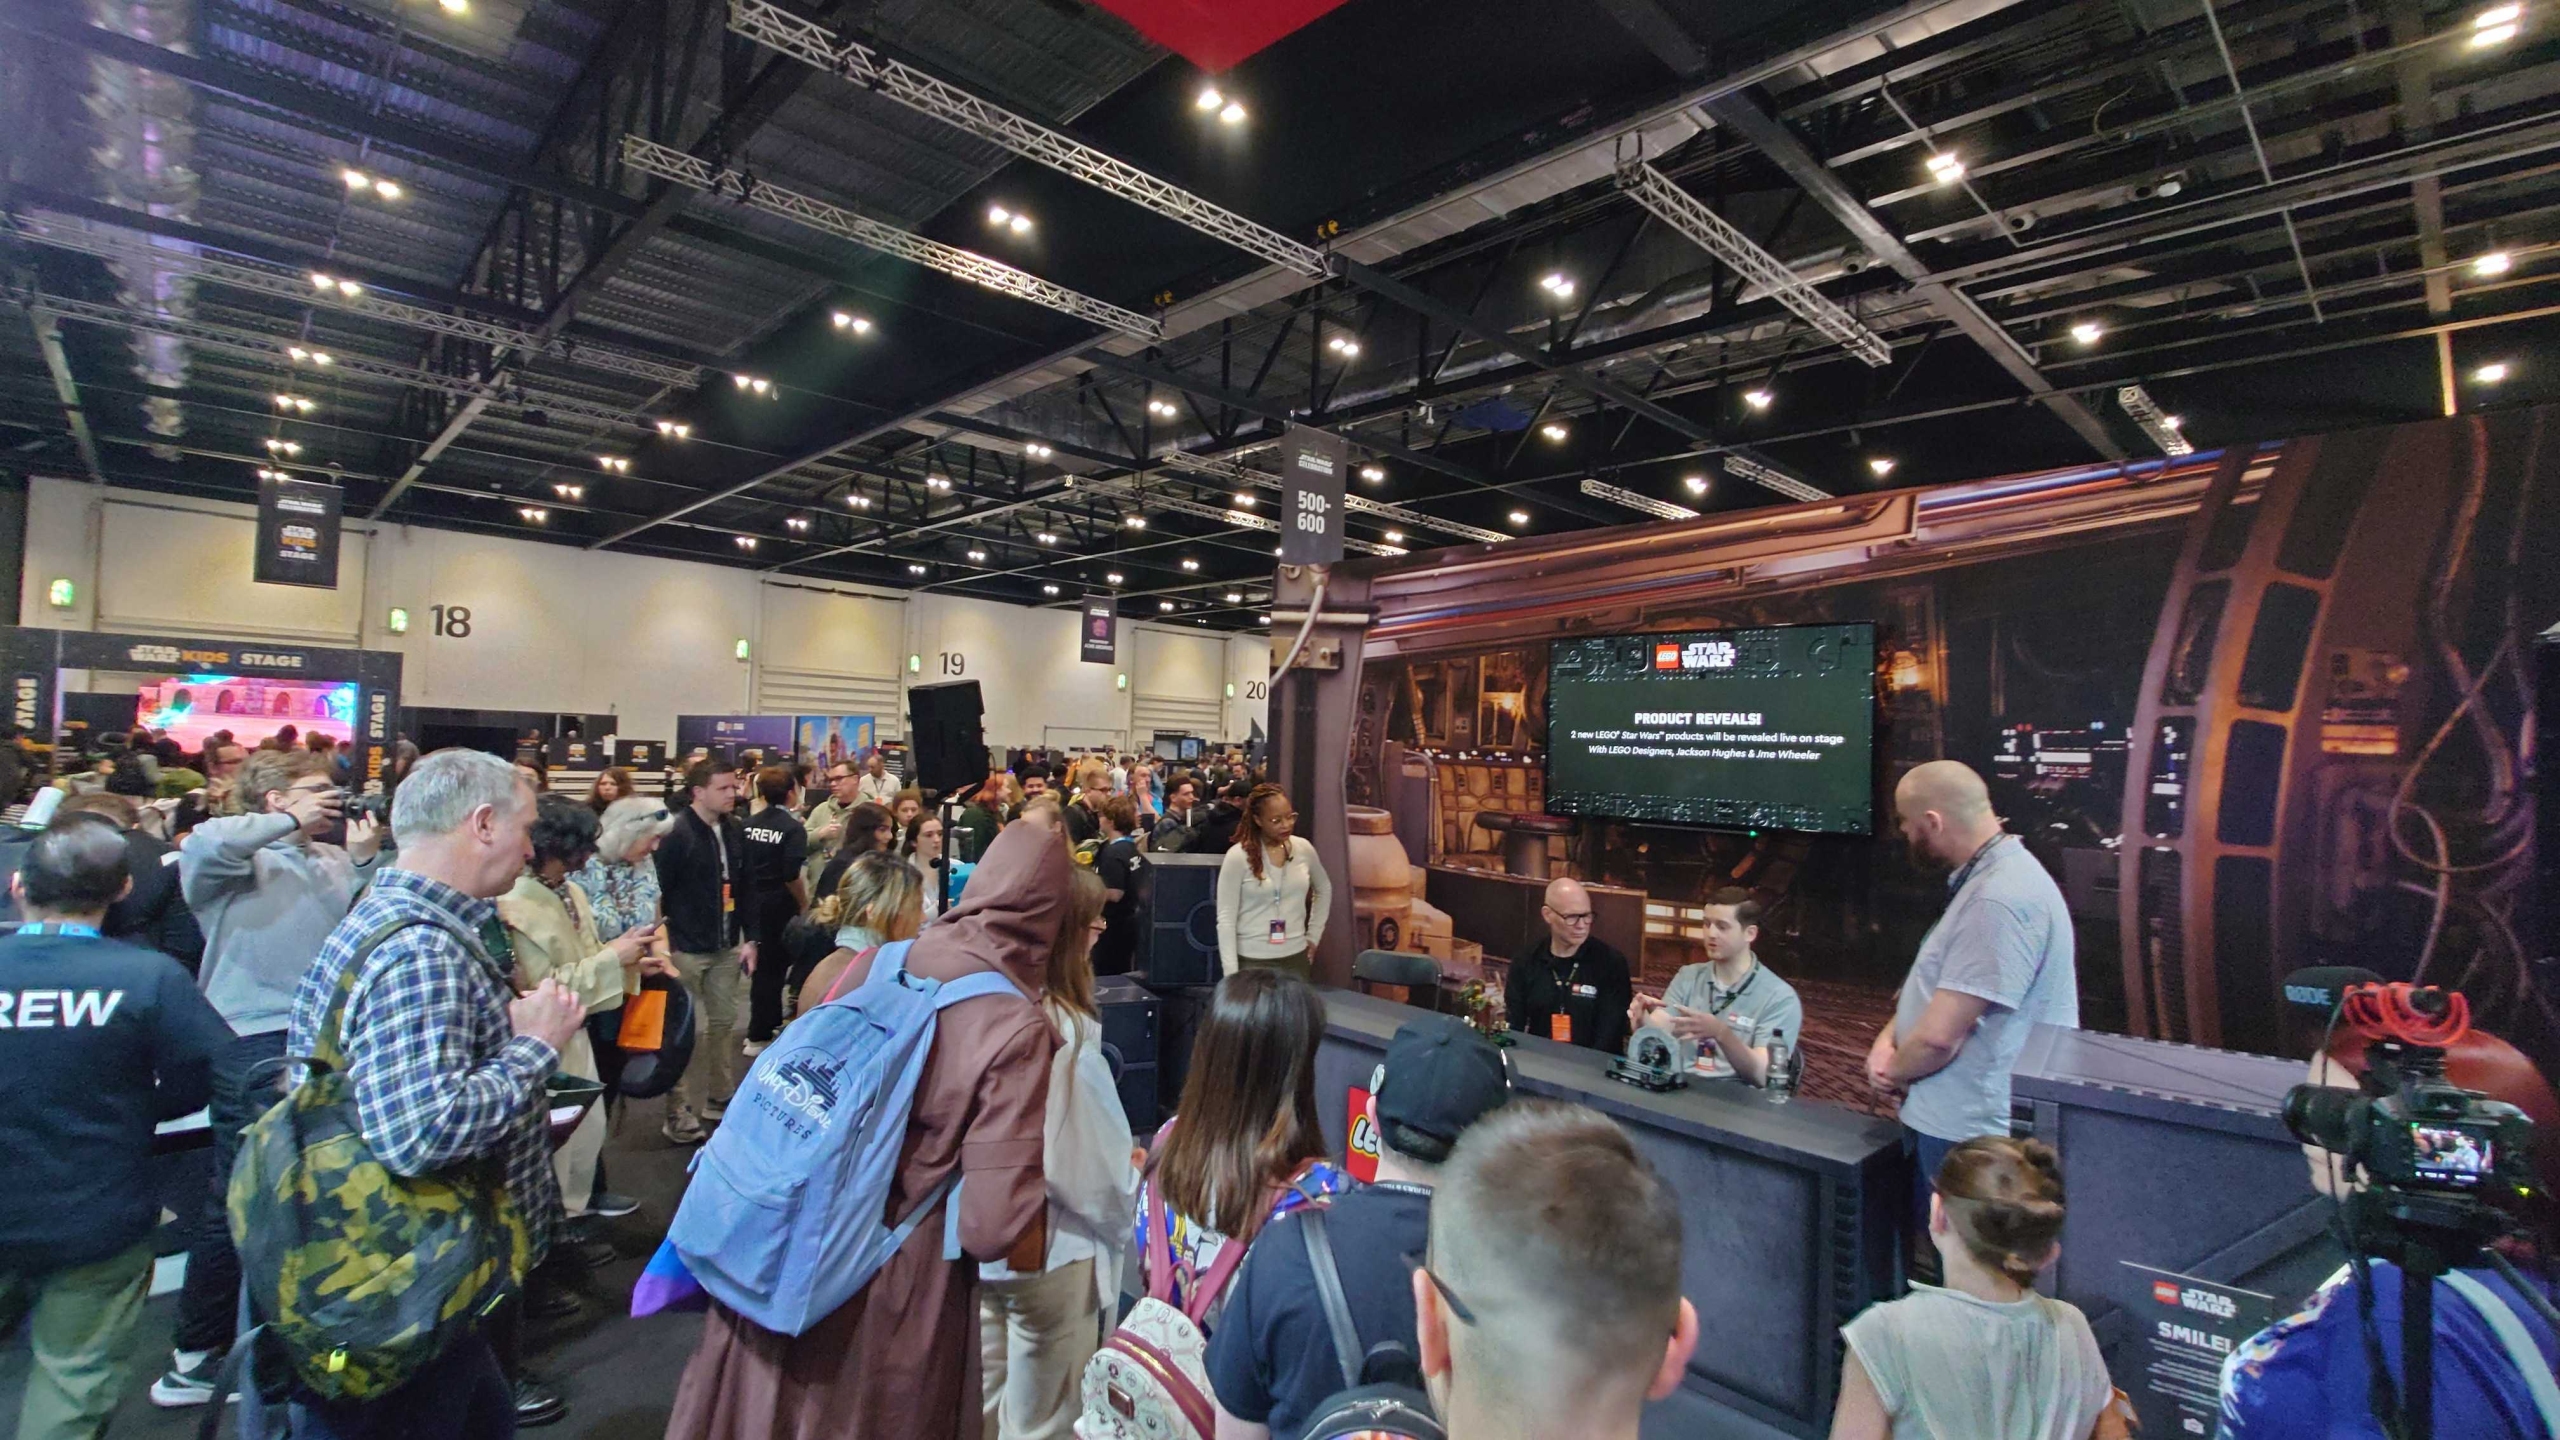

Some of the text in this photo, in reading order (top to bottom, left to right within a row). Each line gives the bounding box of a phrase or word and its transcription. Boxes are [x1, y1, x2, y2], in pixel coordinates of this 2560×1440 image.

[1298, 490, 1331, 513] 500-
[1297, 512, 1325, 534] 600
[430, 604, 471, 638] 18
[182, 650, 302, 667] KIDS STAGE
[1657, 650, 1678, 662] LEGO
[1682, 642, 1735, 655] STAR
[940, 652, 965, 676] 19
[1682, 654, 1735, 668] WARS
[1246, 681, 1267, 700] 20
[369, 694, 386, 738] STAGE
[1634, 712, 1763, 726] PRODUCT REVEALS!
[1570, 730, 1577, 738] 2
[1621, 731, 1638, 740] Star
[1665, 733, 1704, 743] products
[1705, 732, 1721, 741] will
[1723, 732, 1735, 742] be
[1738, 733, 1777, 743] revealed
[1780, 733, 1796, 743] live
[1799, 735, 1812, 743] on
[1814, 735, 1844, 746] stage
[1589, 745, 1607, 754] With
[1608, 746, 1631, 755] LEGO
[1632, 747, 1675, 758] Designers,
[1676, 747, 1710, 757] Jackson
[1711, 749, 1746, 759] Hughes
[1747, 750, 1755, 758] &
[1778, 750, 1821, 760] Wheeler
[753, 1092, 812, 1139] PICTURES
[1352, 1117, 1382, 1156] LE
[2181, 1289, 2234, 1307] STAR
[2182, 1297, 2237, 1318] WARS
[2158, 1321, 2232, 1353] SMILE!
